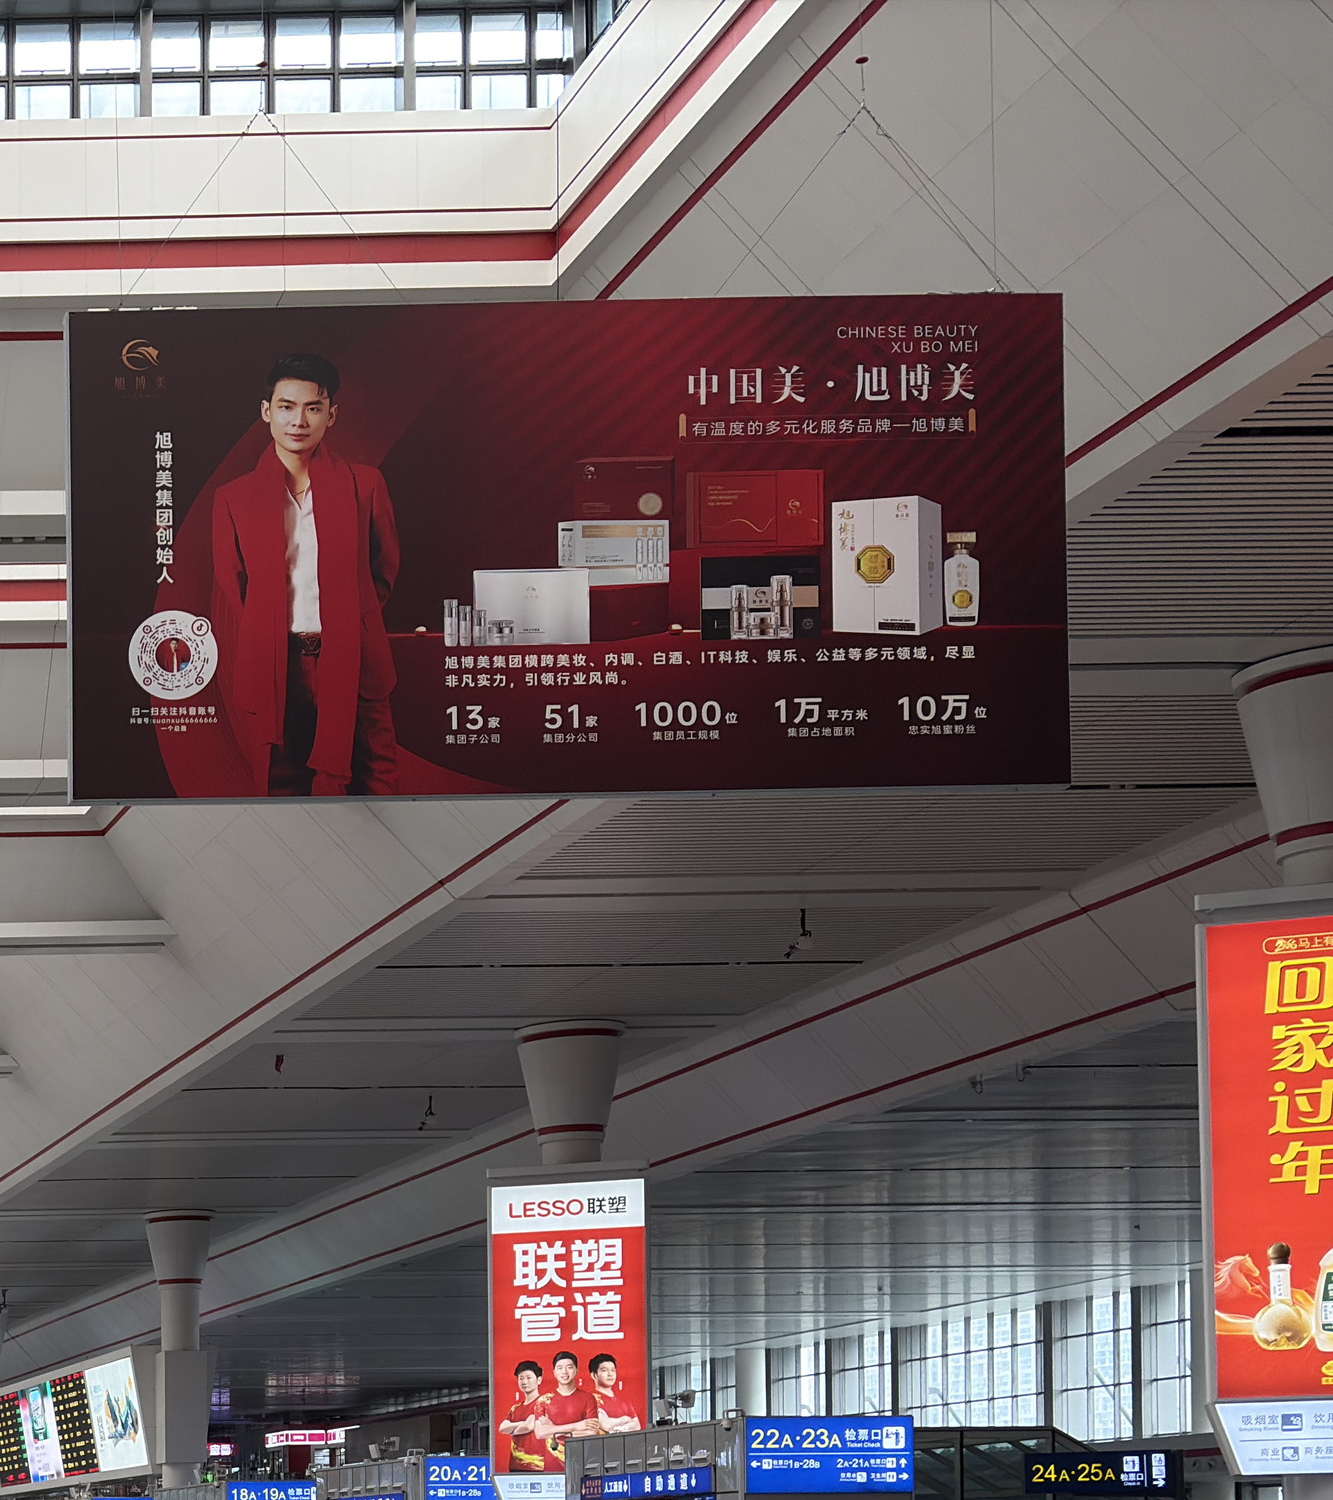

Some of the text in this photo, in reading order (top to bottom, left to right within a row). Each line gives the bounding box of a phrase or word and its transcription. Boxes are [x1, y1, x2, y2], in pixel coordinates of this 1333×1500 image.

[836, 324, 978, 339] CHINESE BEAUTY
[891, 340, 979, 353] XU BO MEI
[154, 431, 174, 585] 旭博美集团创始人
[445, 672, 628, 689] 非凡实力，引领行业风尚。
[445, 733, 501, 745] 集团子公司
[543, 732, 598, 743] 集团分公司
[652, 730, 721, 741] 集团员工规模
[787, 726, 855, 738] 集团占地面积
[509, 1195, 627, 1219] LESSO 联塑
[512, 1238, 624, 1290] 联塑
[514, 1290, 625, 1343] 管道
[1241, 1415, 1279, 1425] 吸烟室
[845, 1428, 881, 1441] 检票口
[429, 1466, 490, 1481] 20A·21
[644, 1473, 688, 1493] 自助通道
